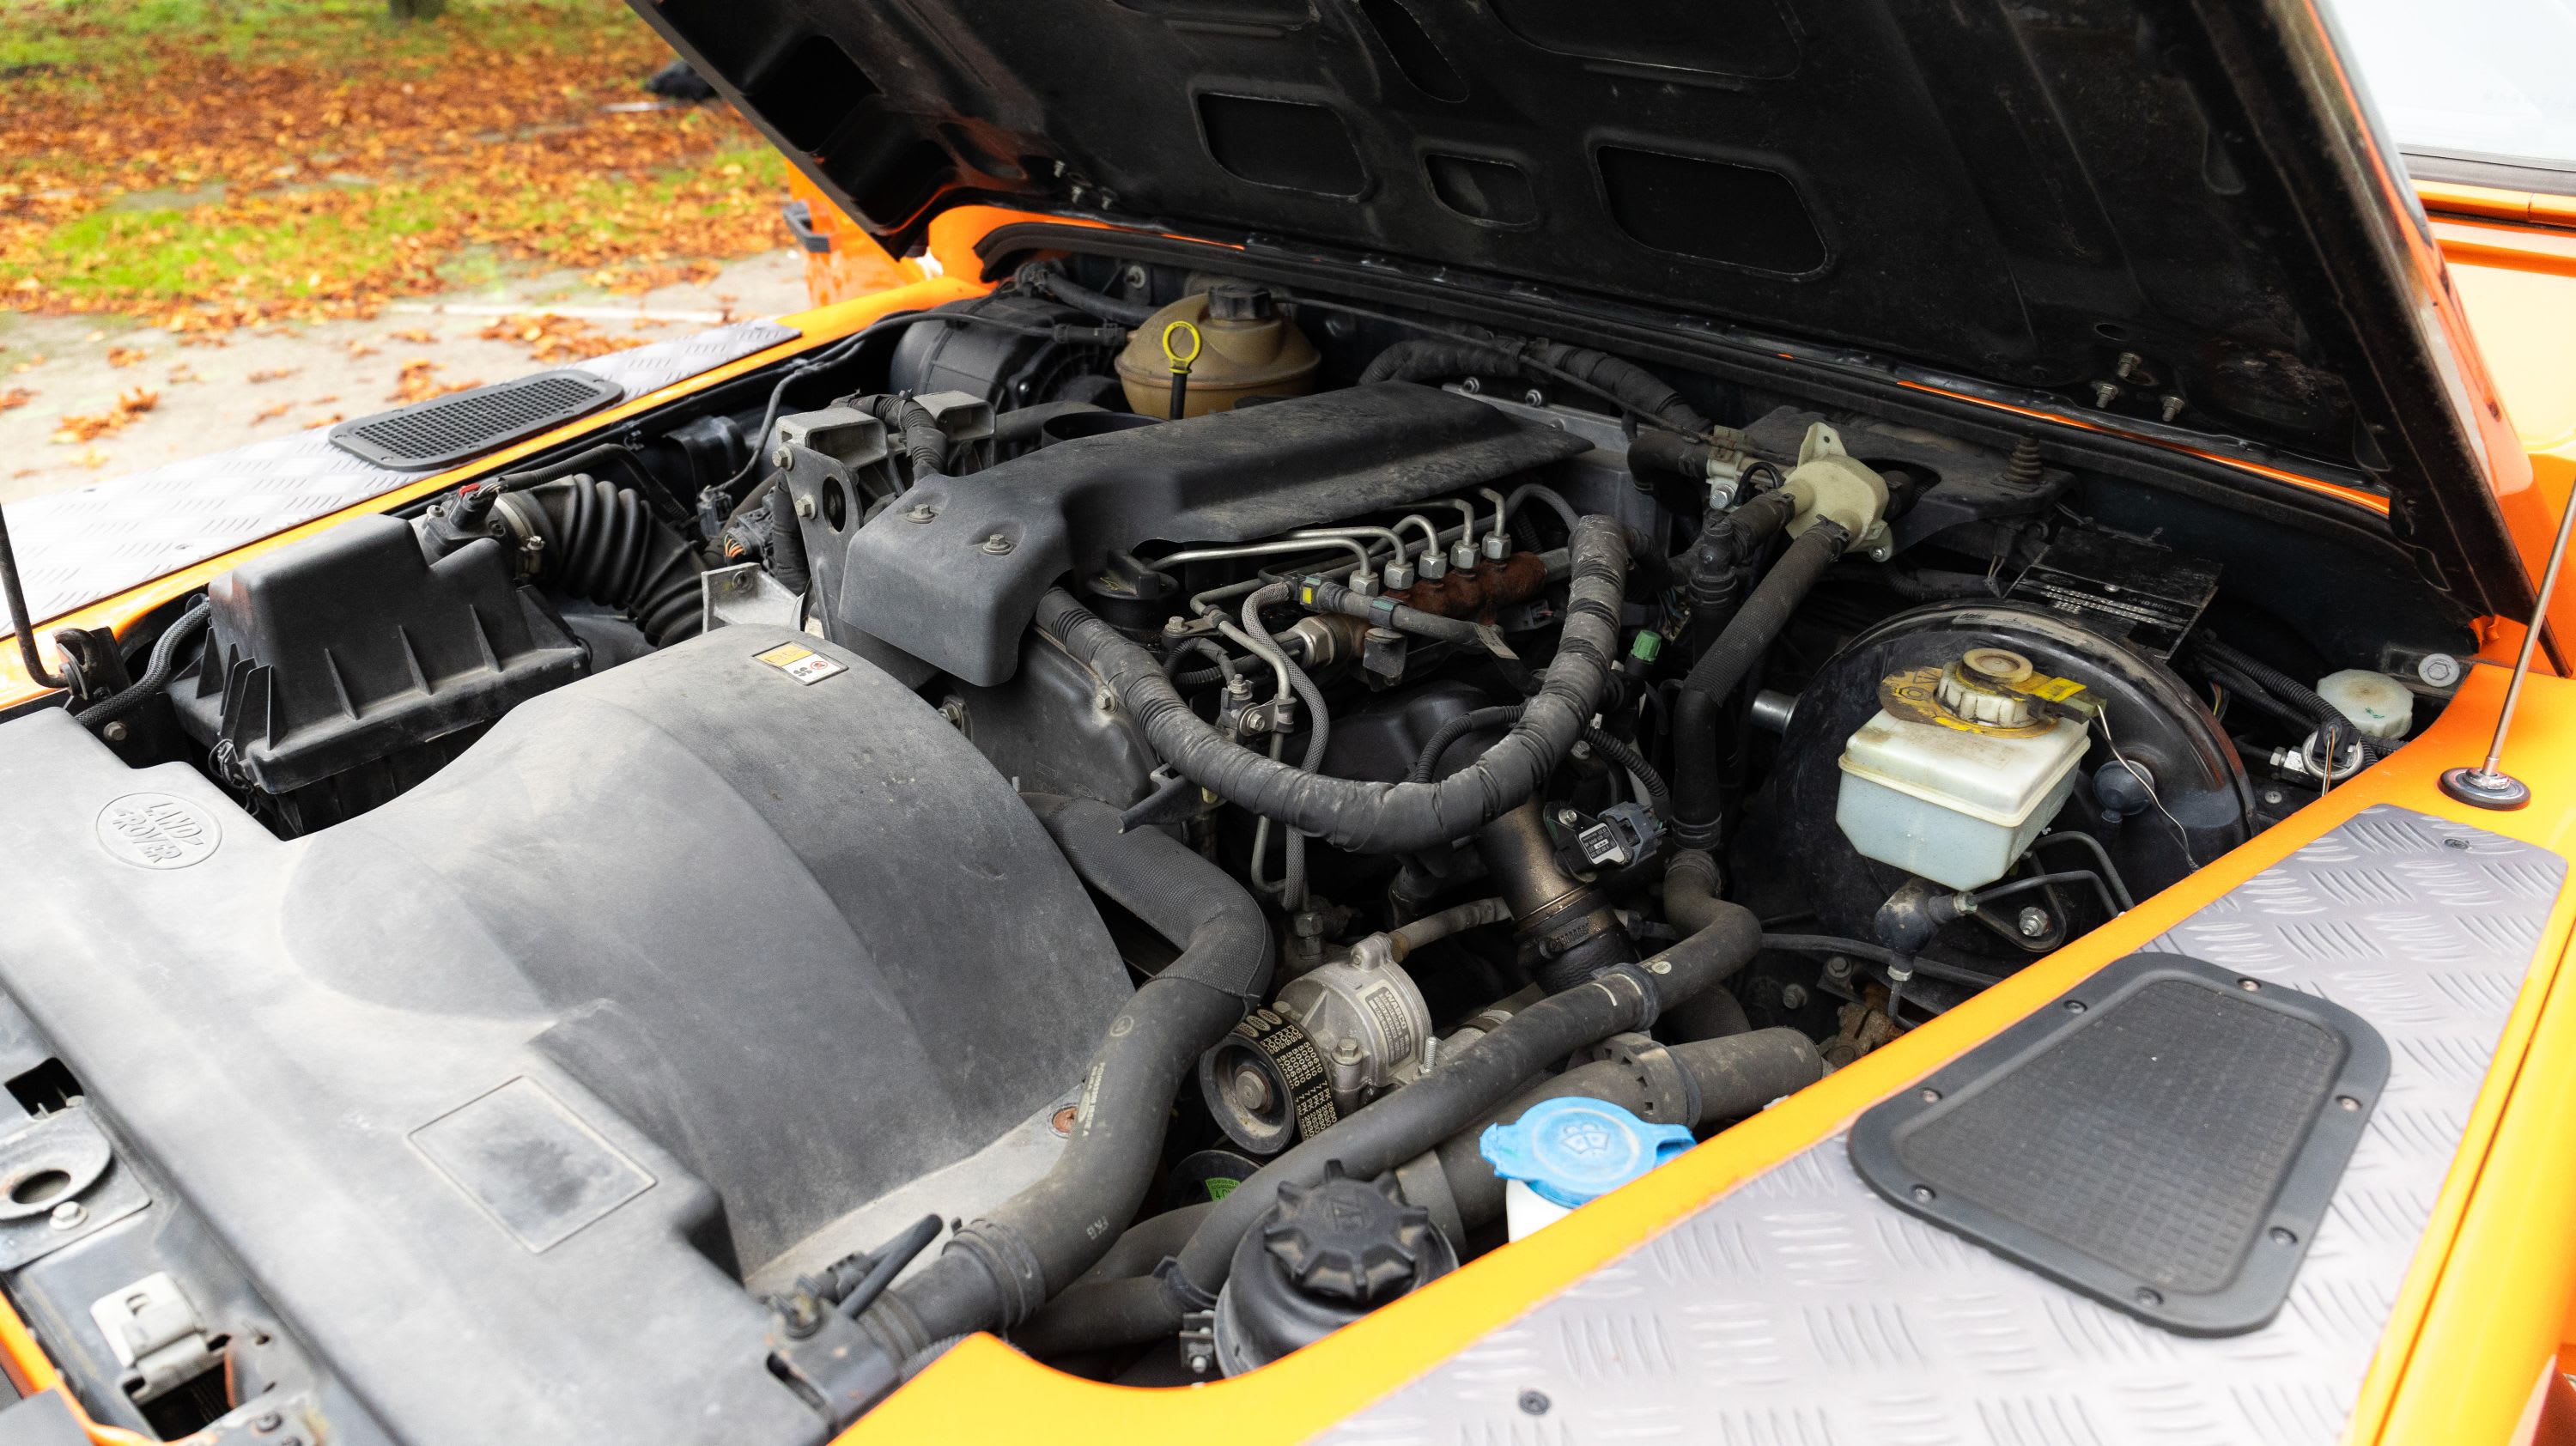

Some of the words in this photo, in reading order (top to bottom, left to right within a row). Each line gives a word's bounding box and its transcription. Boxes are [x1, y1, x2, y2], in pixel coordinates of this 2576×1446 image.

[1384, 990, 1407, 1030] WABCO
[1269, 1034, 1286, 1049] PQS
[1275, 1031, 1292, 1046] PQS
[1281, 1028, 1298, 1042] PQS
[1287, 1024, 1303, 1040] PQS
[1263, 1037, 1280, 1053] PQS
[1285, 1051, 1306, 1084] 500610
[1291, 1048, 1312, 1080] 500610
[1297, 1045, 1318, 1077] 500610
[1303, 1042, 1323, 1073] 500610
[1279, 1054, 1300, 1087] 500610
[1306, 1097, 1315, 1111] PK
[1312, 1095, 1321, 1108] PK
[1317, 1091, 1326, 1104] PK
[1323, 1087, 1332, 1101] PK
[1300, 1101, 1309, 1115] PK
[1321, 1105, 1332, 1127] 2630
[1327, 1102, 1338, 1123] 2630
[1303, 1115, 1315, 1137] 2630
[1309, 1111, 1321, 1133] 2630
[1315, 1108, 1327, 1130] 2630
